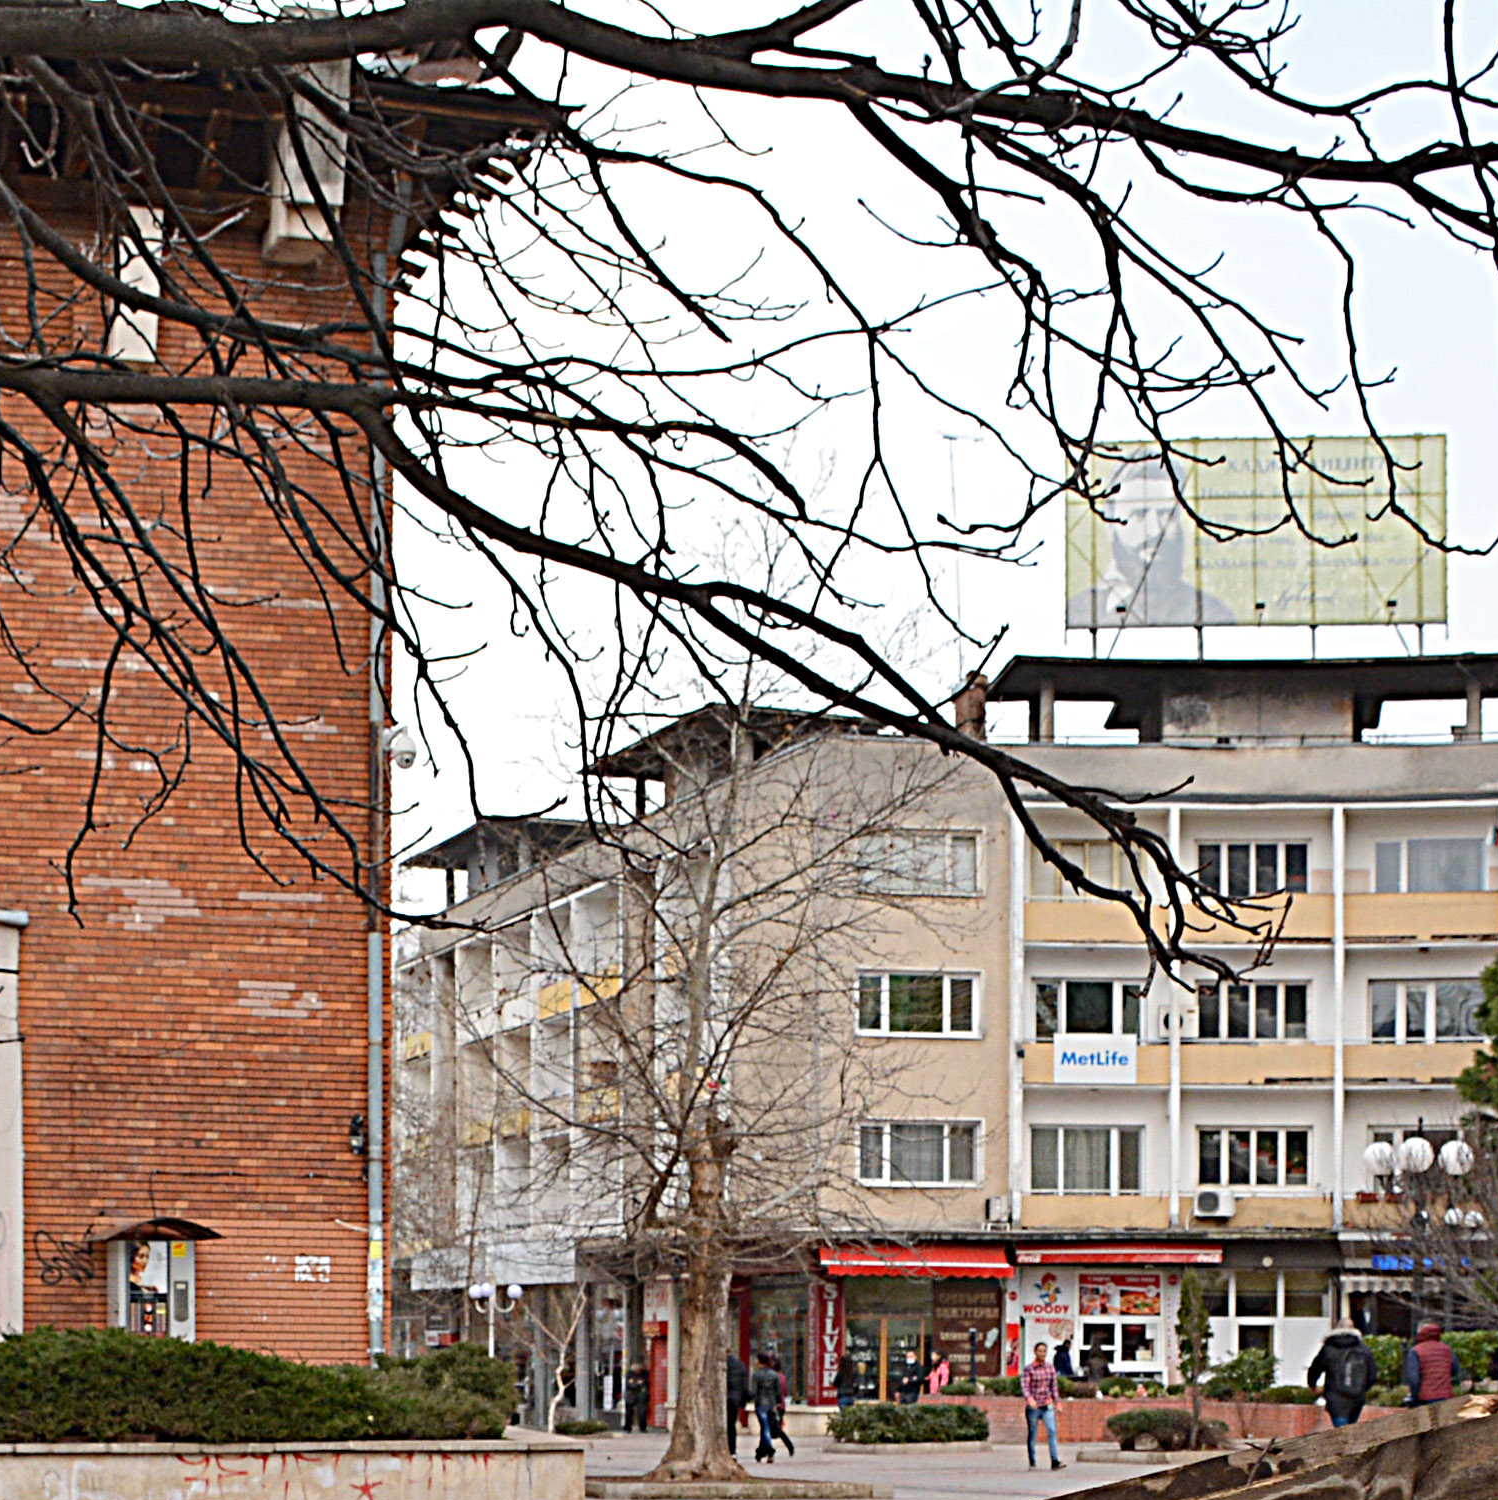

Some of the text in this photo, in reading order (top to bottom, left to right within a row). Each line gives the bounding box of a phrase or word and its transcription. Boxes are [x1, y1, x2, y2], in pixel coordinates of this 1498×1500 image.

[1061, 1050, 1129, 1066] MetLife
[1023, 1304, 1069, 1314] WOODY
[822, 1283, 840, 1388] SILVER
